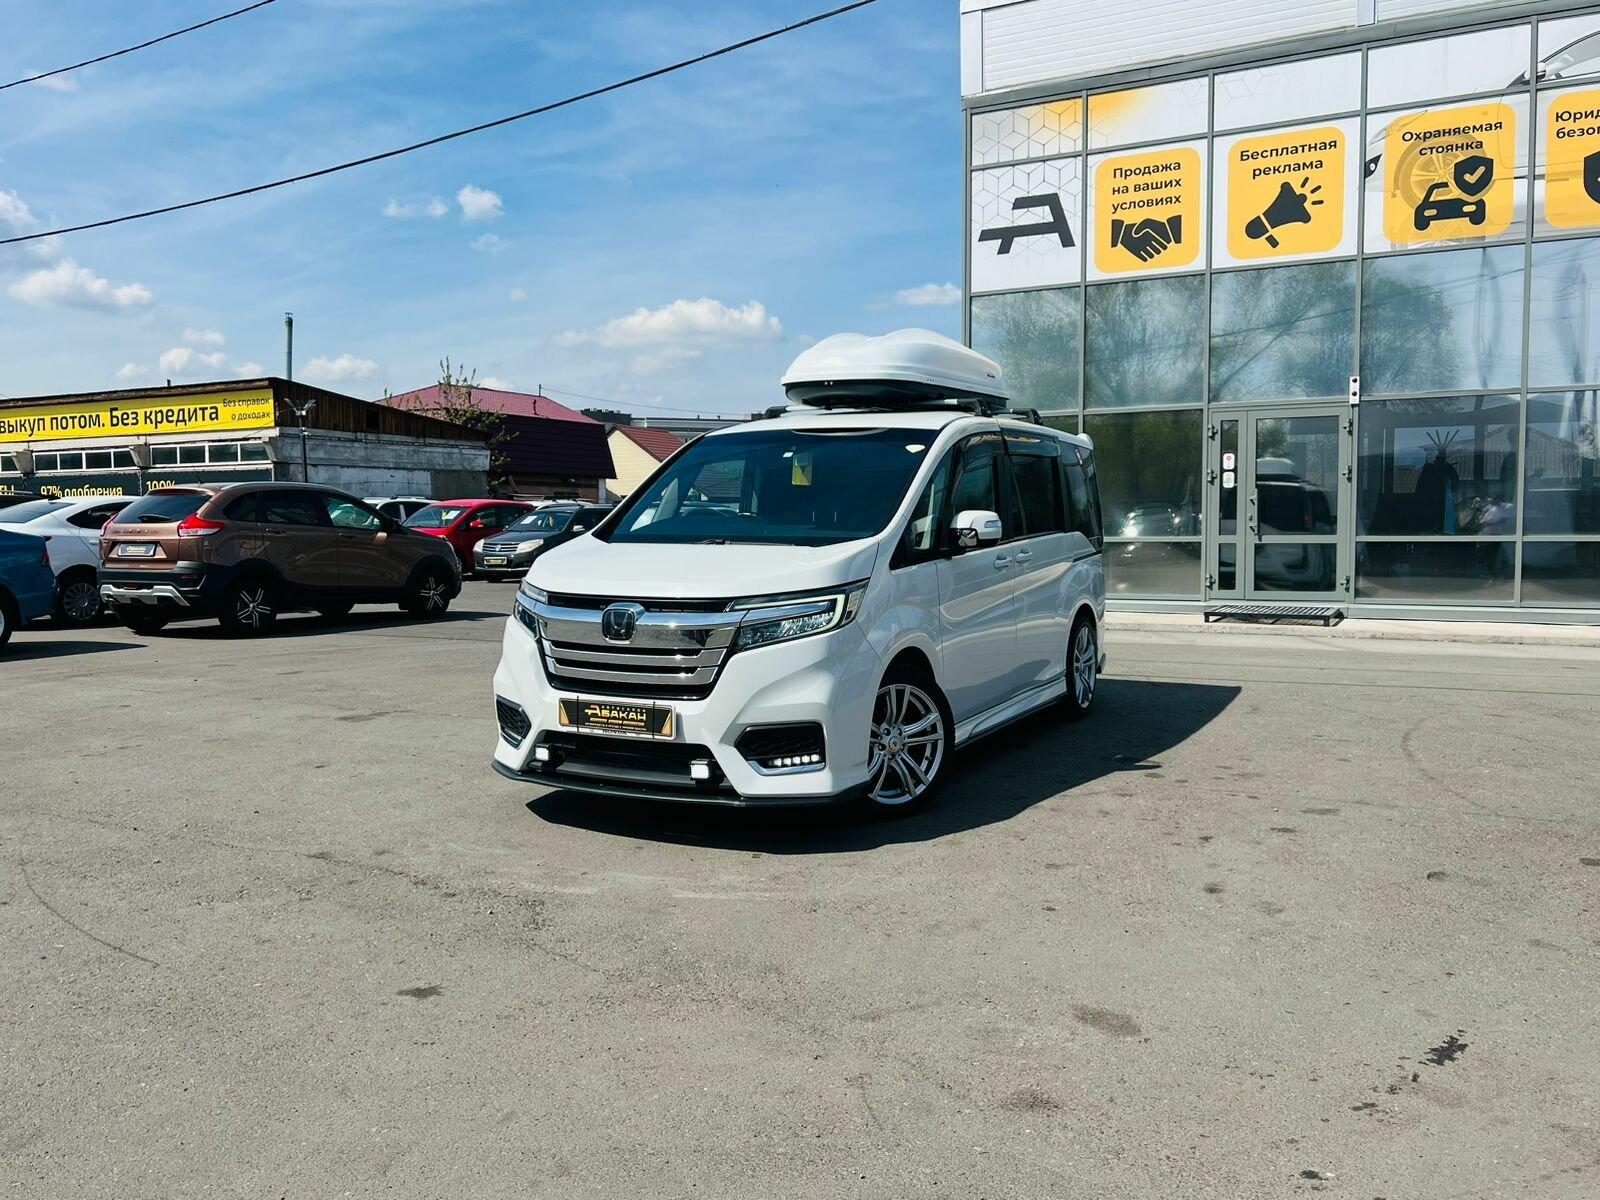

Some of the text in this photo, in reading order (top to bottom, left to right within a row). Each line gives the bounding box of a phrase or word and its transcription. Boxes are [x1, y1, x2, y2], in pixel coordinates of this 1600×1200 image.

[1401, 121, 1503, 143] Охраняемая
[1240, 139, 1338, 162] Бесплатная
[1419, 140, 1484, 156] стоянка
[1113, 161, 1181, 180] Продажа
[1252, 158, 1324, 180] реклама
[1112, 177, 1182, 196] на ваших
[1111, 194, 1182, 213] условиях
[222, 397, 270, 408] Без справок
[0, 404, 219, 437] выкуп потом. Без кредита
[231, 411, 270, 422] о доходах
[40, 484, 123, 498] 97% одобрения
